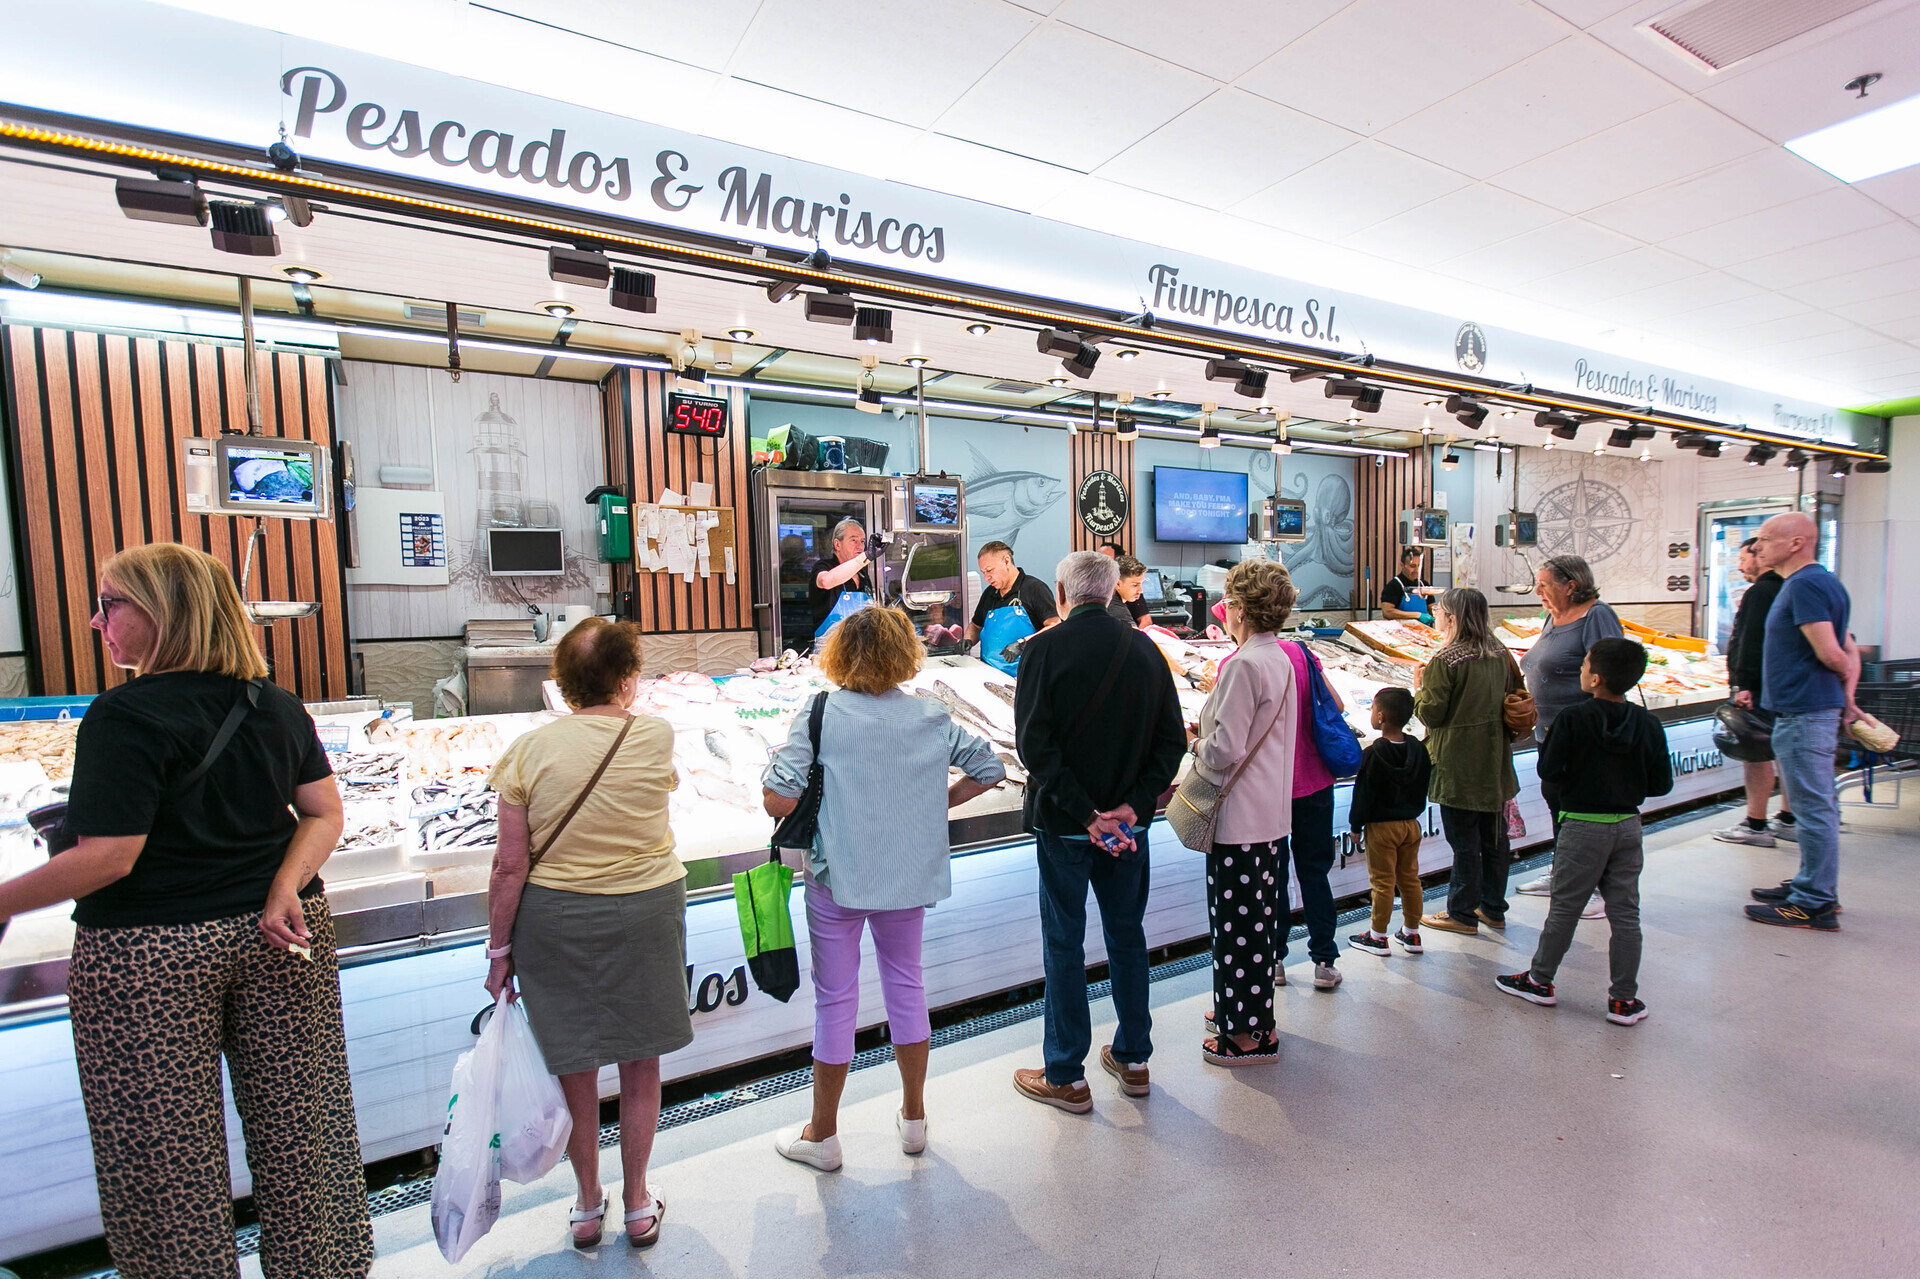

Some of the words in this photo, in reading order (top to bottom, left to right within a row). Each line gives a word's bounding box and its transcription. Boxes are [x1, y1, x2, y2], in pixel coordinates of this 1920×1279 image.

[280, 66, 632, 201] Pescados
[650, 150, 704, 212] &
[717, 166, 945, 263] Mariscos
[1148, 264, 1294, 334] Fiurpesca
[1301, 298, 1340, 343] S.l.
[1575, 358, 1644, 400] Pescados
[1647, 374, 1659, 402] &
[1662, 377, 1718, 414] Mariscos
[675, 404, 723, 432] 540
[694, 400, 719, 408] TURNO
[1168, 500, 1191, 508] MAKE
[1191, 501, 1207, 509] YOU
[1198, 509, 1231, 518] TONIGHT
